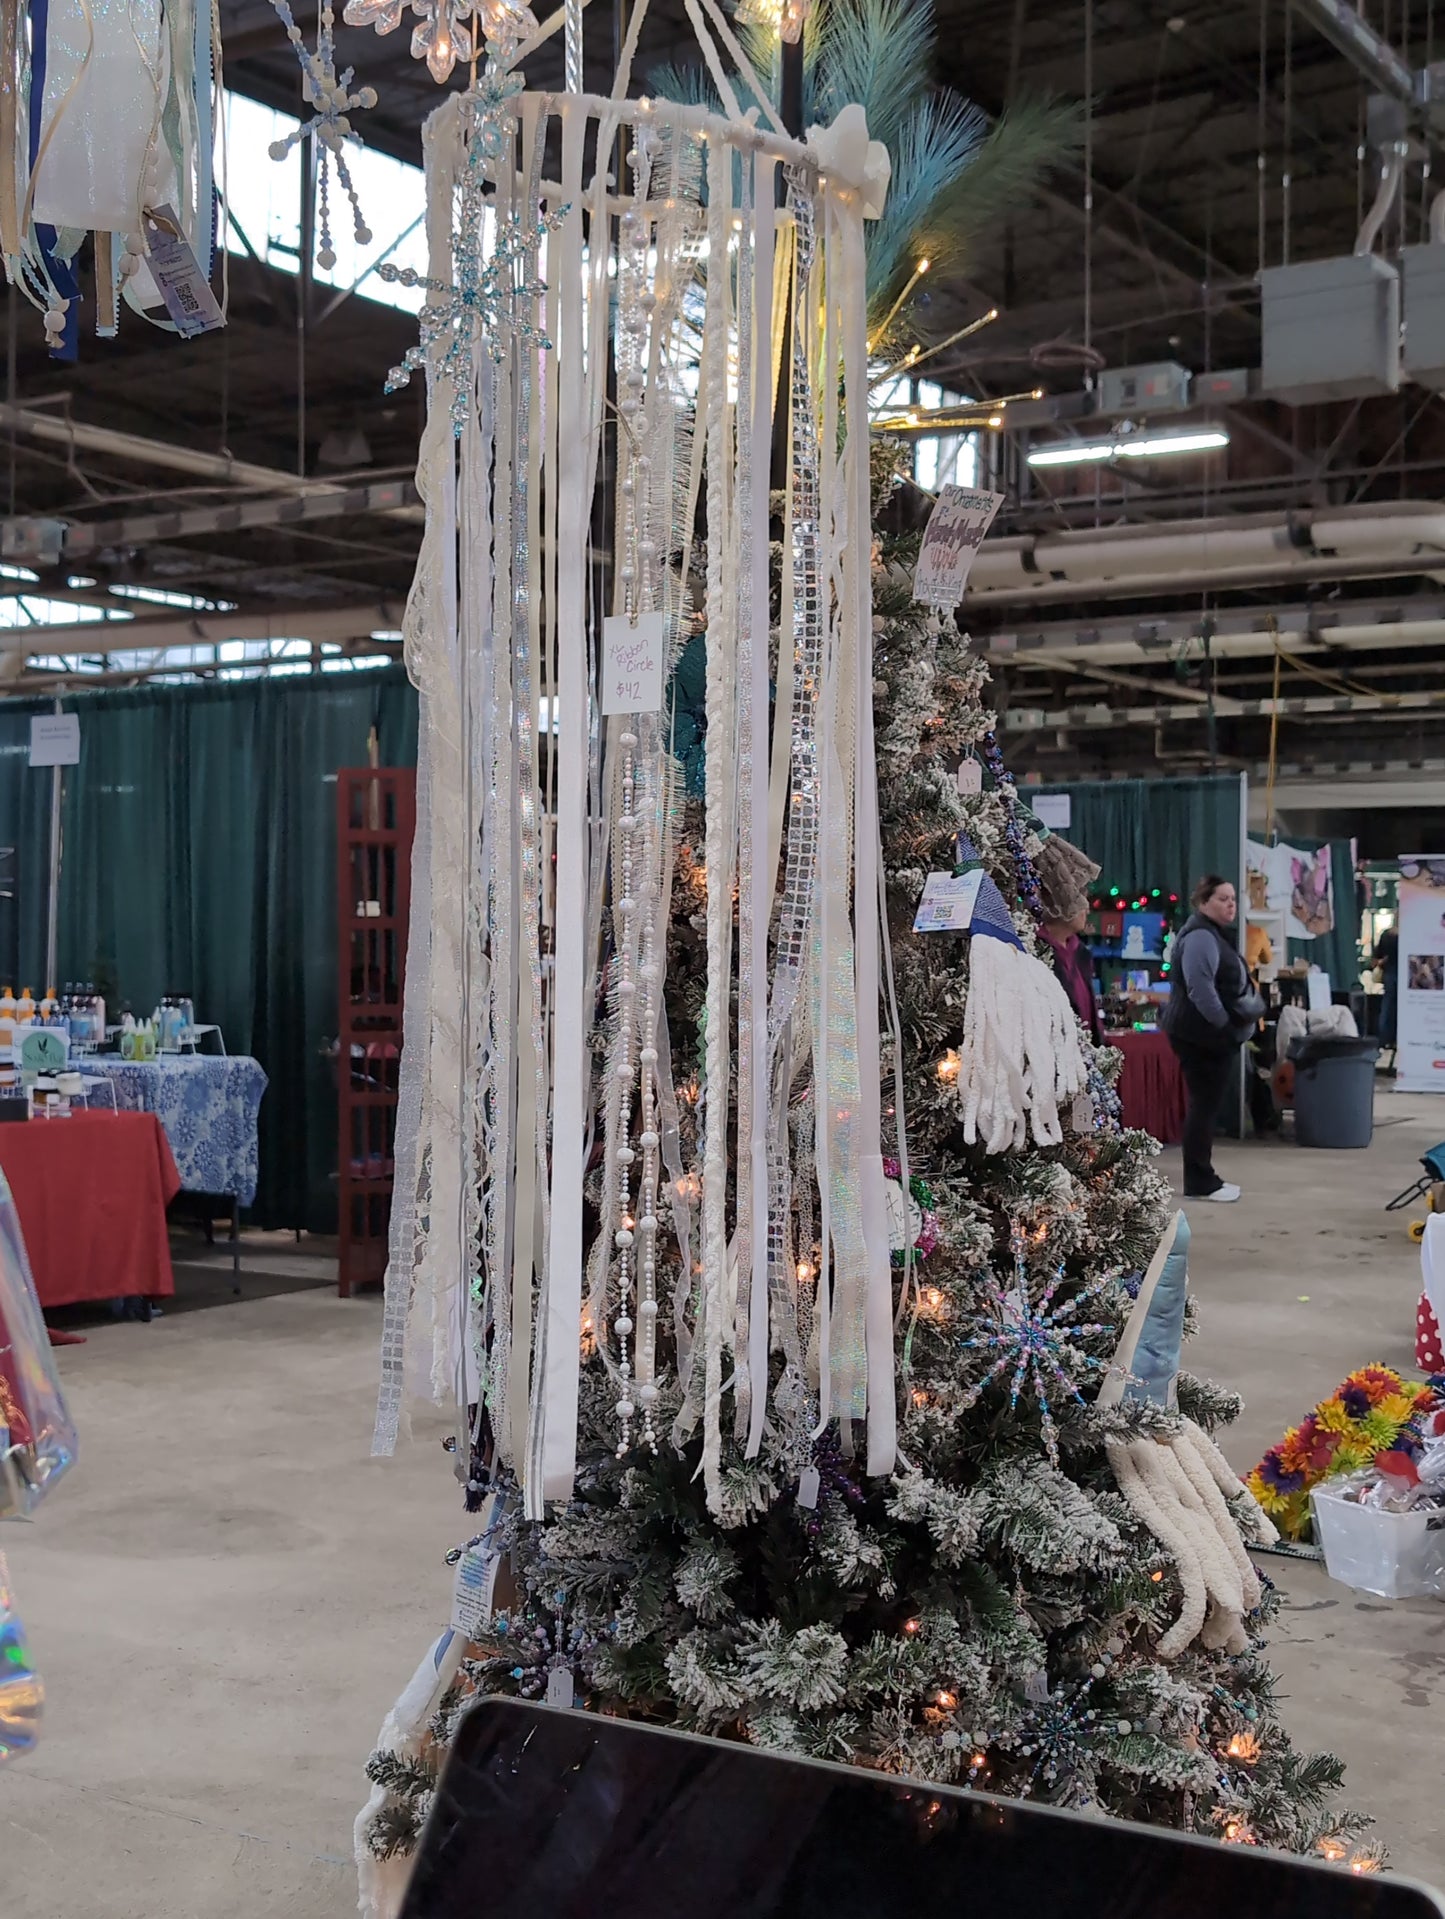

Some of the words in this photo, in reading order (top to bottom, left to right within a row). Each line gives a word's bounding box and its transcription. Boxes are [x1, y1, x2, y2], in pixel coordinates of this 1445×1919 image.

[616, 639, 649, 667] Ribbon
[626, 656, 654, 673] Circle
[615, 681, 642, 700] $42
